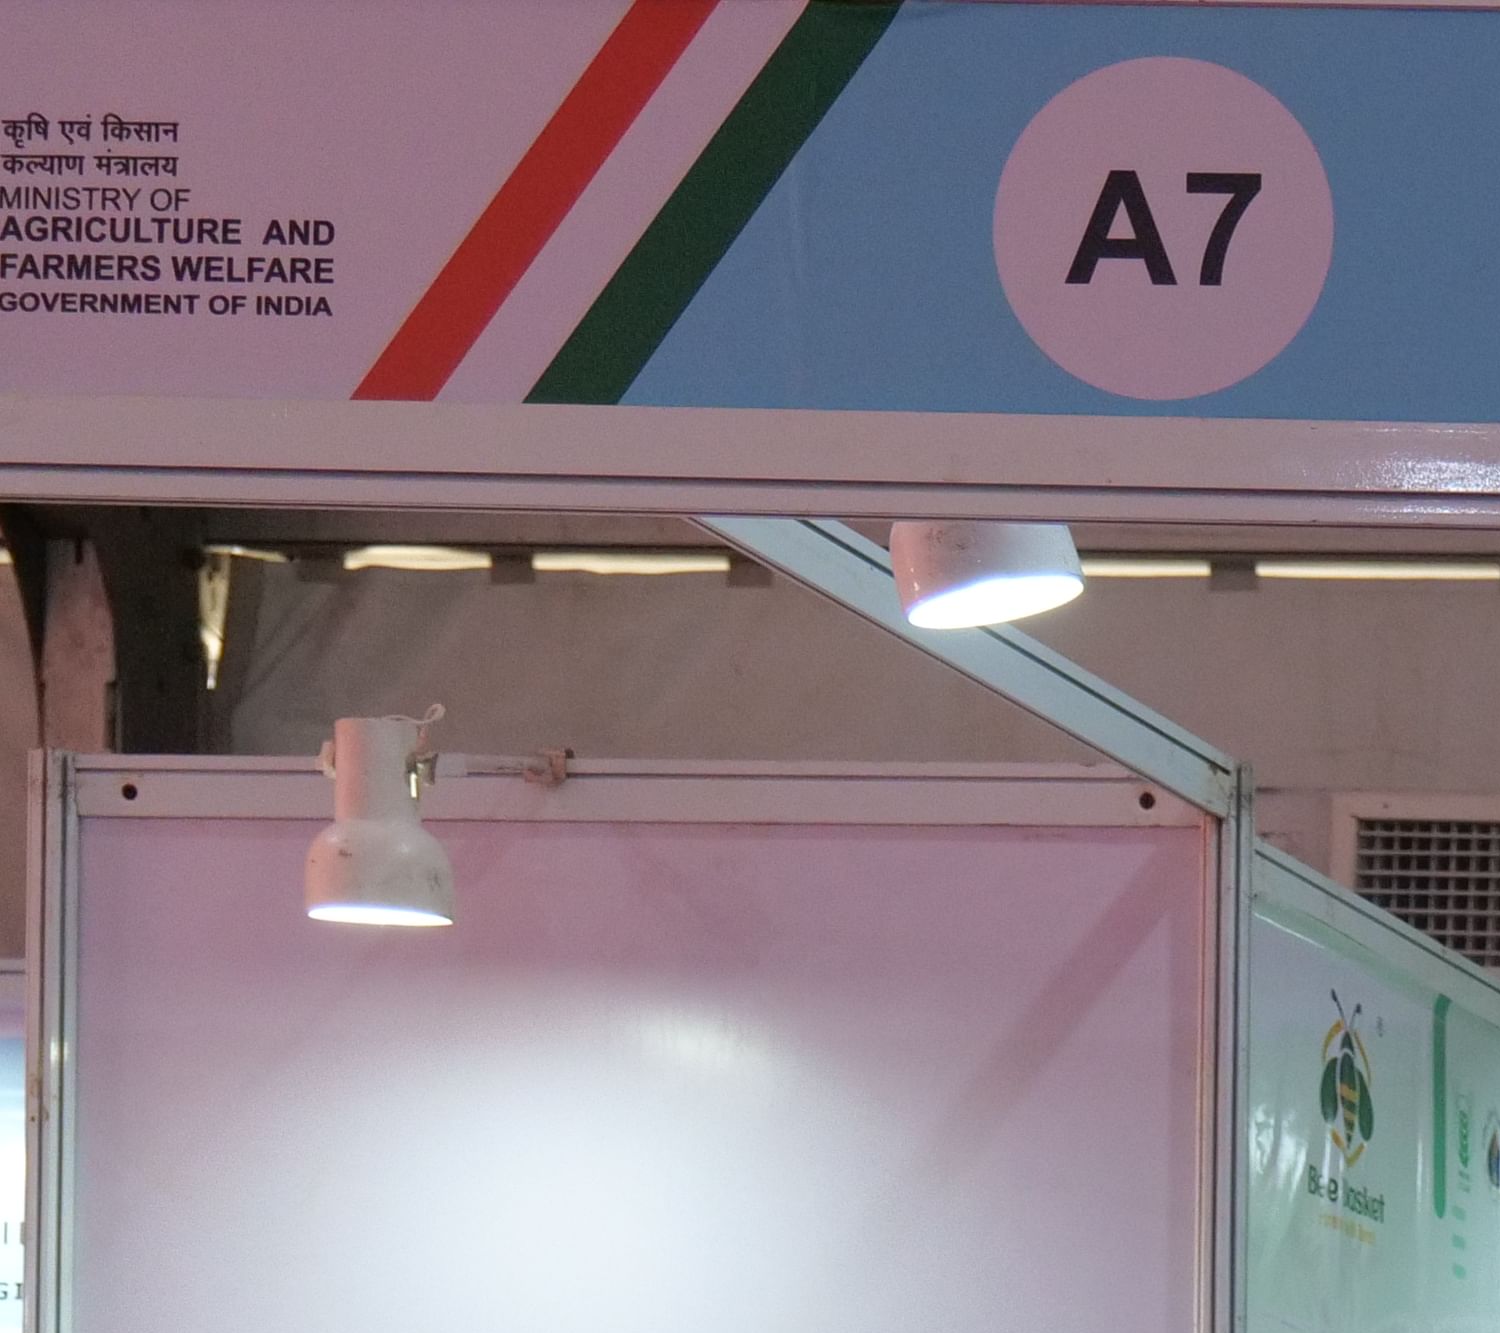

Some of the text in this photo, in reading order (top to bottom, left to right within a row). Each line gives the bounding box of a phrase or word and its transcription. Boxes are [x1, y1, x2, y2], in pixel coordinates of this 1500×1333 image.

[2, 113, 179, 148] कृषि एवं किसान
[1, 148, 178, 177] कल्याण मंत्रालय
[0, 186, 190, 211] MINISTRY OF
[0, 216, 334, 245] AGRICULTURE AND
[1065, 170, 1261, 285] A7
[0, 254, 333, 283] FARMERS WELFARE
[0, 292, 332, 316] GOVERNMENT OF INDIA
